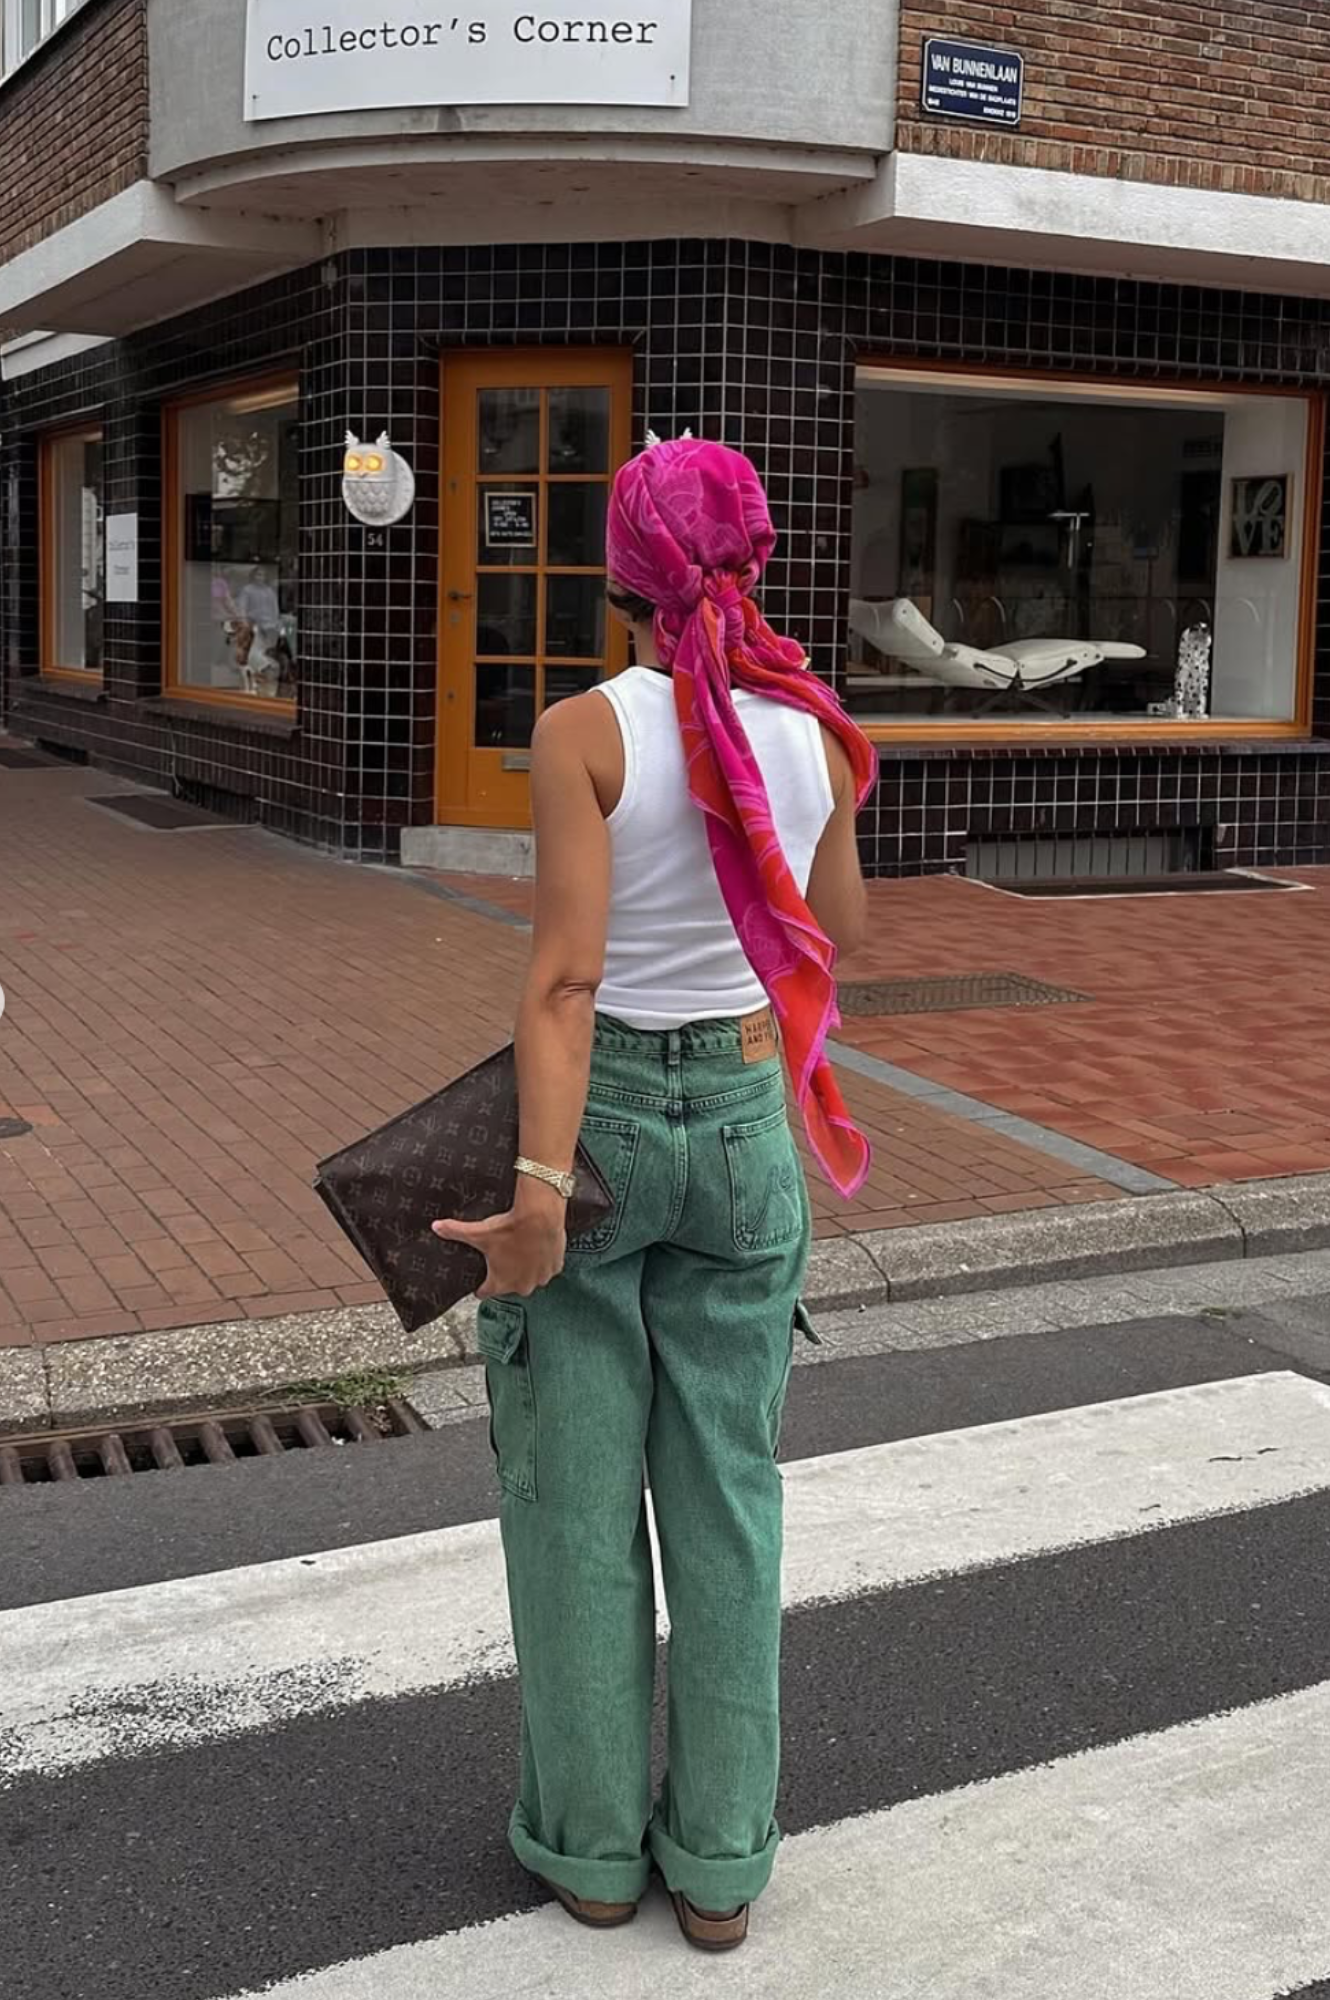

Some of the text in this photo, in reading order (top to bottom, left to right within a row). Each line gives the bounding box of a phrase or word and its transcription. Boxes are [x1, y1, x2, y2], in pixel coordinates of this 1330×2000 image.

[267, 15, 658, 61] Collector's Corner
[931, 53, 1018, 84] VAN BUNNENLAAN
[367, 533, 384, 547] 54
